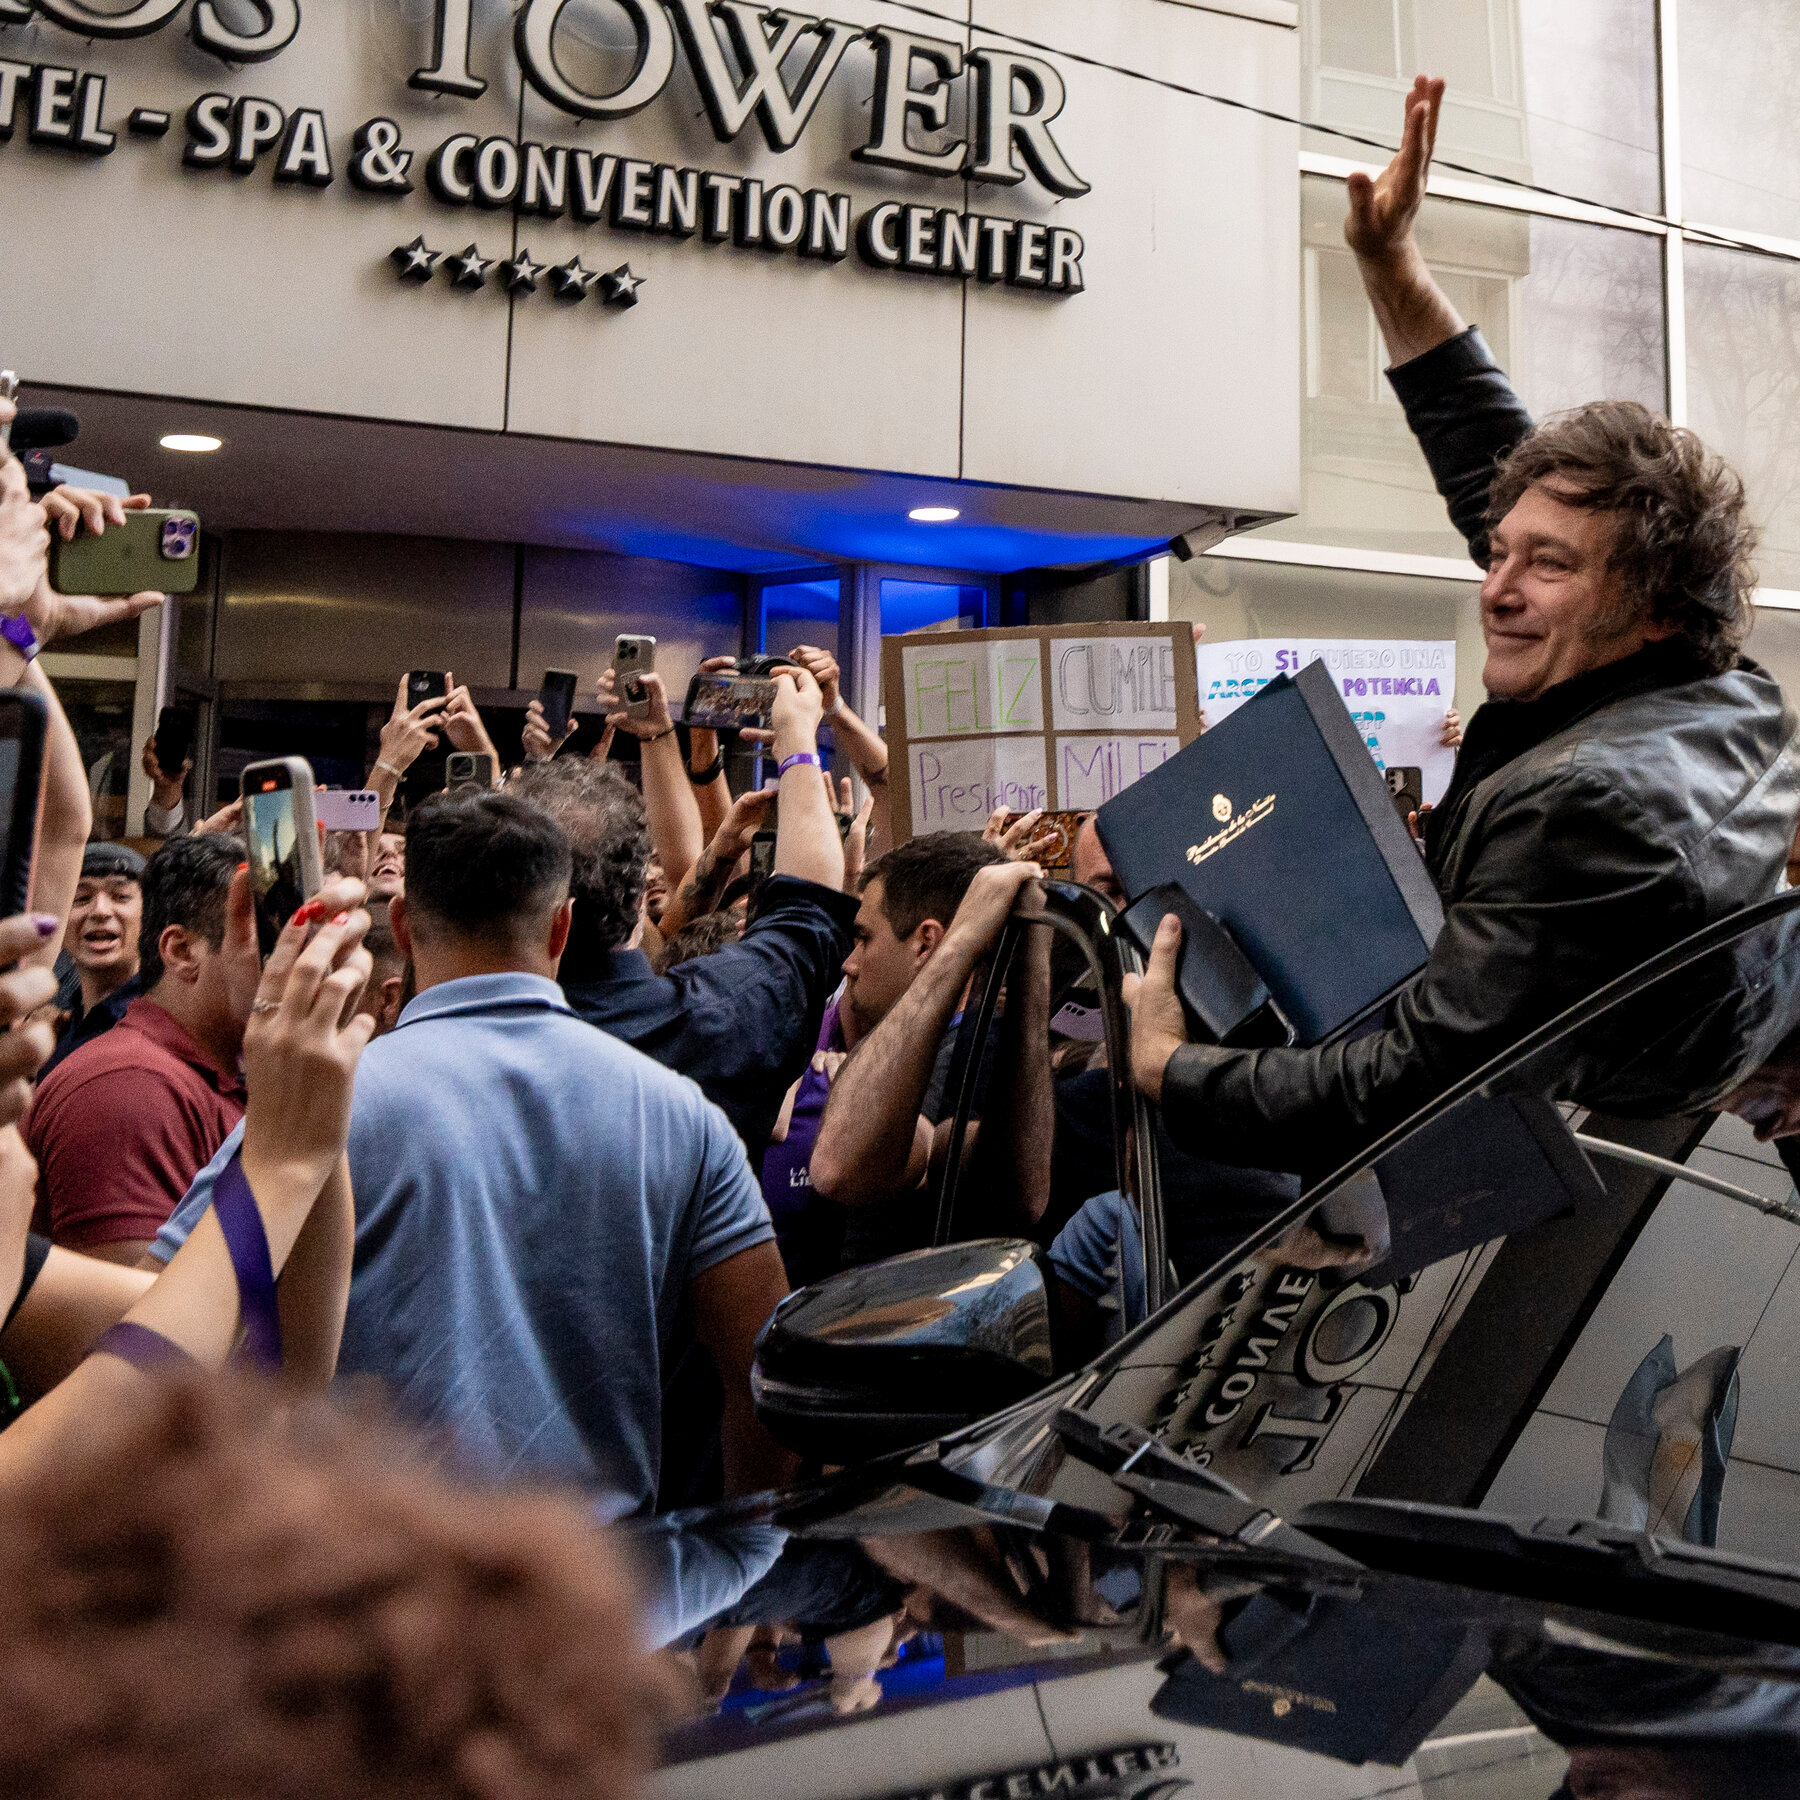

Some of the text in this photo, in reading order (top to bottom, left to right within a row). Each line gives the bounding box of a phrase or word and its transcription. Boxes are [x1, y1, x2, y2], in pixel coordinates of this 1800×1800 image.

[183, 92, 334, 187] SPA
[350, 117, 414, 193] &
[427, 132, 850, 262] CONVENTION
[858, 202, 1086, 294] CENTER
[1224, 650, 1263, 673] YO
[1400, 648, 1447, 670] UNA
